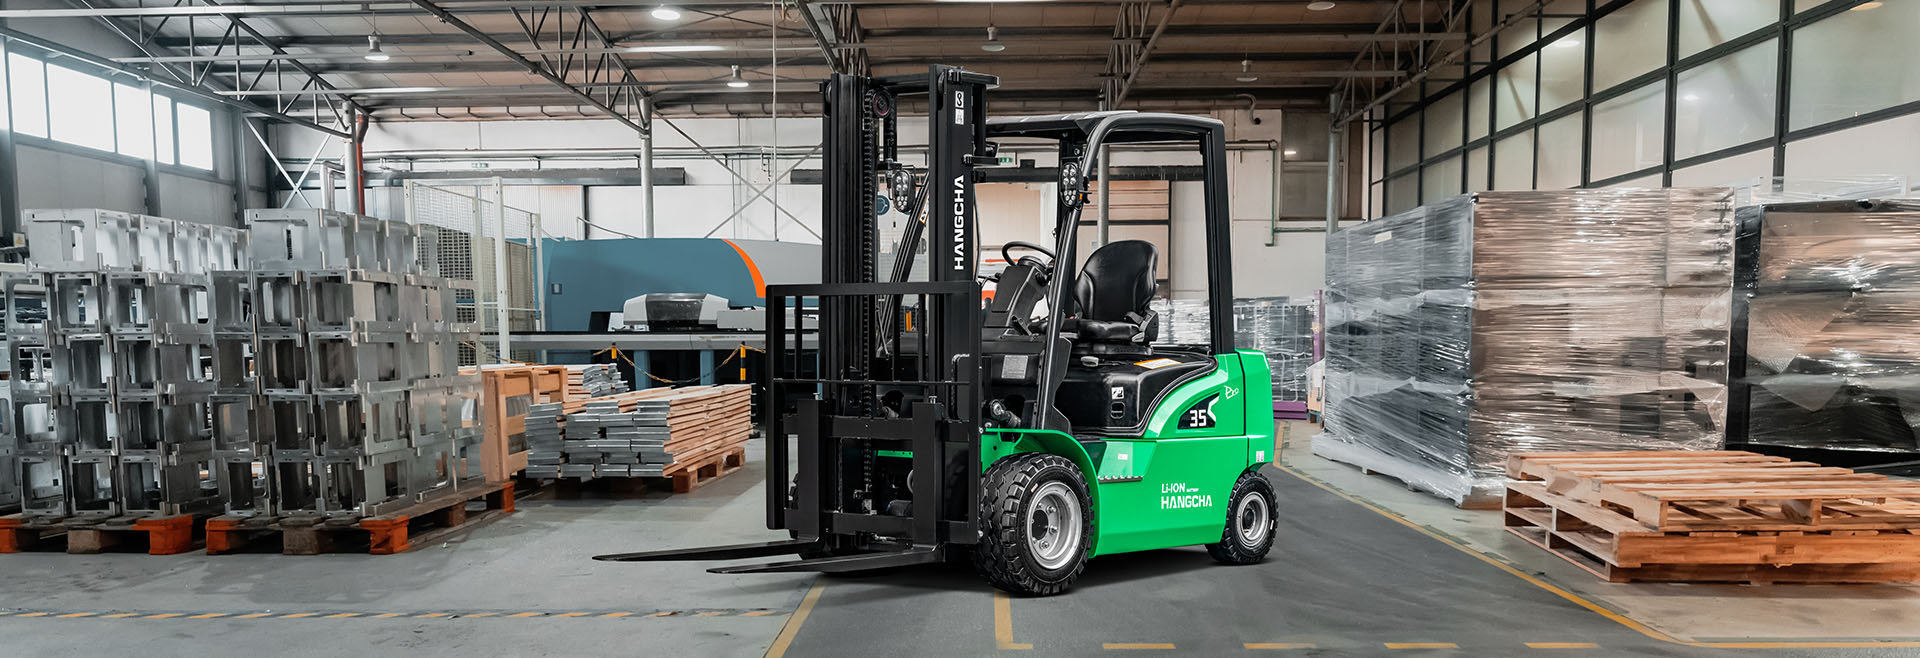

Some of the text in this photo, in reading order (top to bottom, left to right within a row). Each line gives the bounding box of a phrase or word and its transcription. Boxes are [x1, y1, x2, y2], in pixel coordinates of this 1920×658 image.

[954, 175, 964, 270] HANGCHA
[1189, 409, 1207, 427] 35
[1161, 495, 1212, 509] HANGCHA
